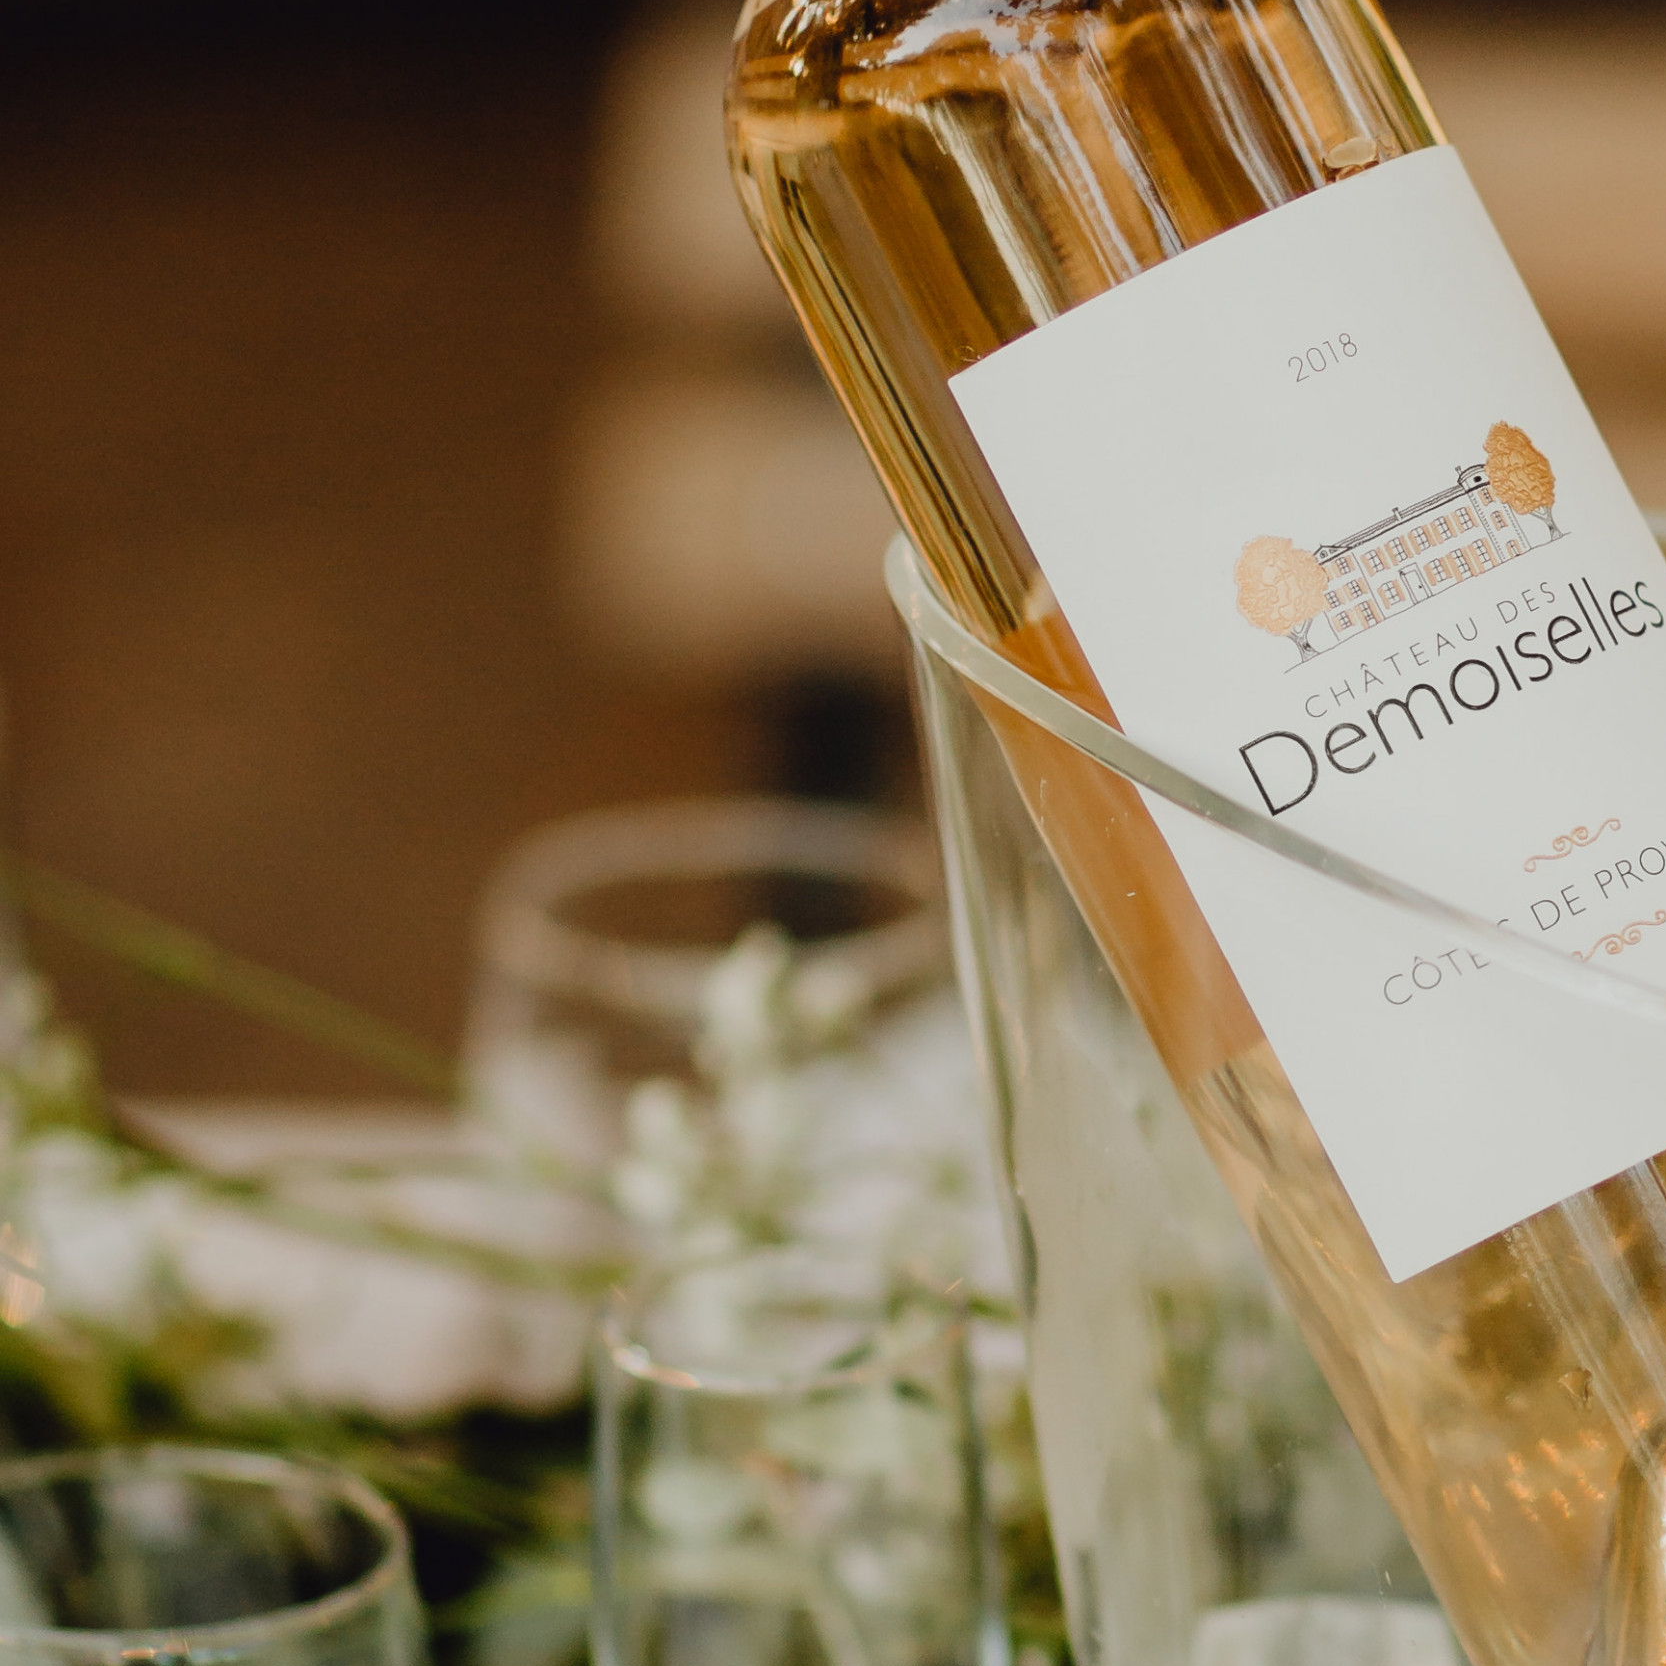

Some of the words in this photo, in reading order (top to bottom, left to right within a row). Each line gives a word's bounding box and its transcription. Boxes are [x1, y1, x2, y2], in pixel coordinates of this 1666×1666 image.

[1287, 332, 1358, 383] 2018
[1238, 576, 1665, 817] Demoiselles
[1304, 616, 1479, 719] CHÂTEAU
[1496, 581, 1557, 625] DES
[1382, 918, 1510, 1005] CÔTE
[1529, 884, 1587, 931] DE
